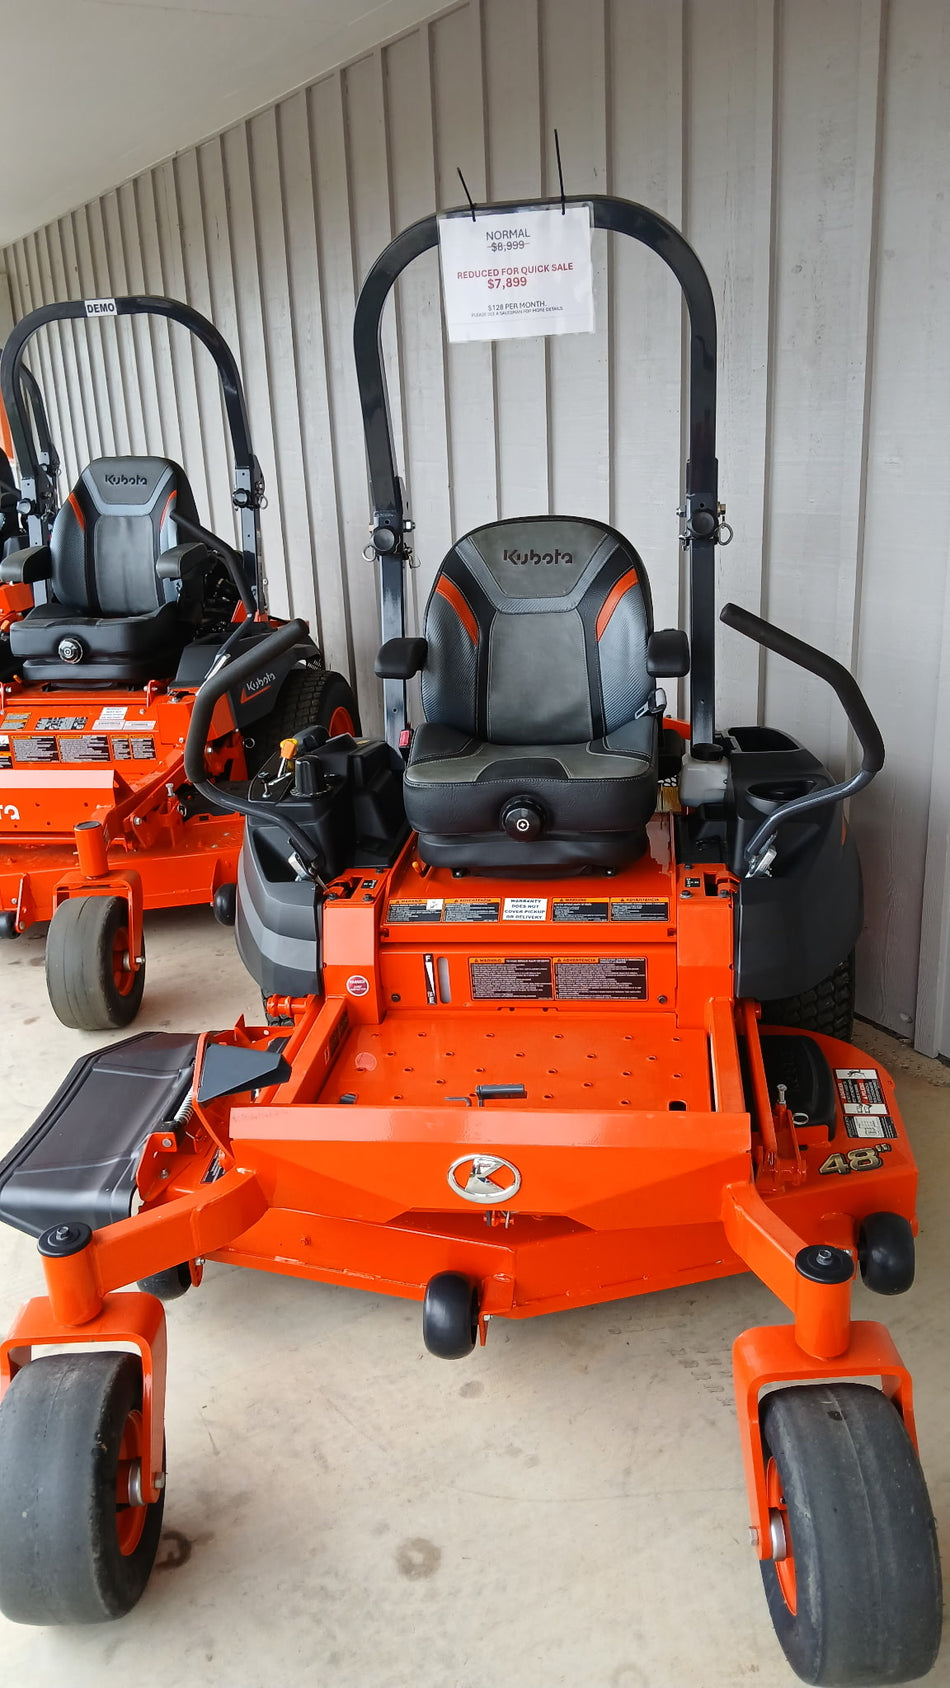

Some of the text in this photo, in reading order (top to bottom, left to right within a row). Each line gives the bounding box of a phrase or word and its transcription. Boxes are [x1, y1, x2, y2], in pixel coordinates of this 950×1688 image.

[486, 228, 530, 241] NORMAL
[490, 240, 525, 252] $8,999
[457, 262, 574, 279] REDUCED FOR QUICK SALE
[487, 276, 527, 290] $7,899
[86, 303, 115, 313] DEMO
[504, 302, 519, 310] PER
[105, 474, 148, 485] Kubota
[503, 549, 573, 565] Kubota
[246, 672, 276, 691] Kubota
